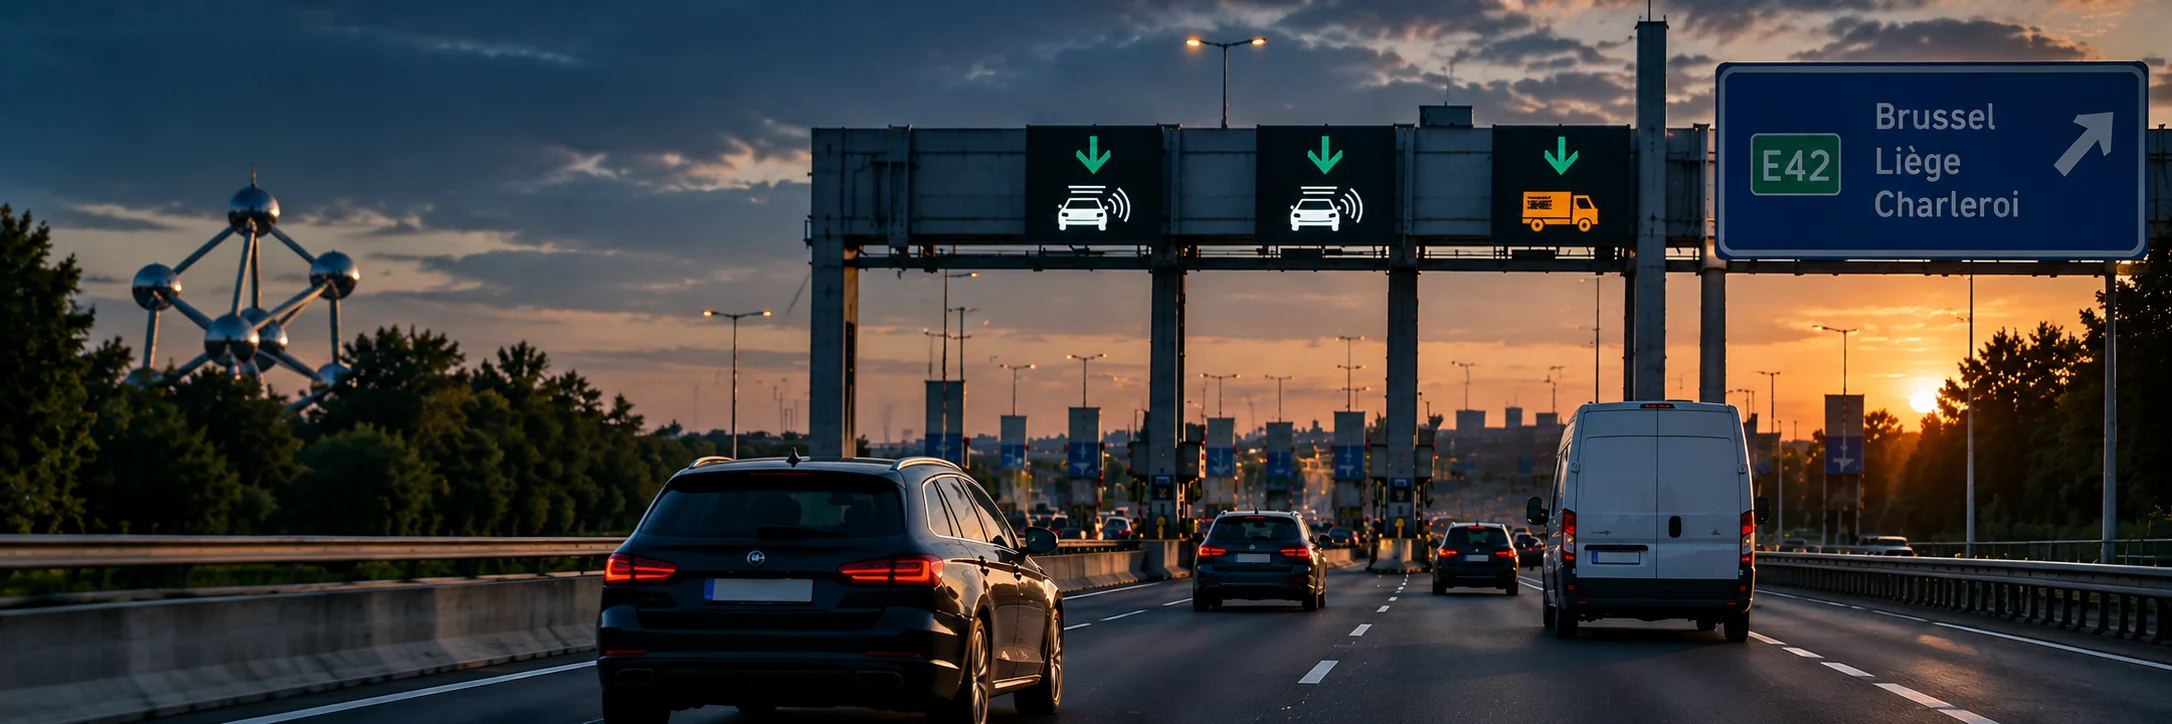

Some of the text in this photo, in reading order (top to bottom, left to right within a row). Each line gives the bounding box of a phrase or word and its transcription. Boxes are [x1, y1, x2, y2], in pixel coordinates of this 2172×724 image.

[1875, 102, 1996, 130] Brussel
[1763, 149, 1830, 182] E42
[1875, 145, 1961, 182] Liège
[1874, 190, 2019, 218] Charleroi
